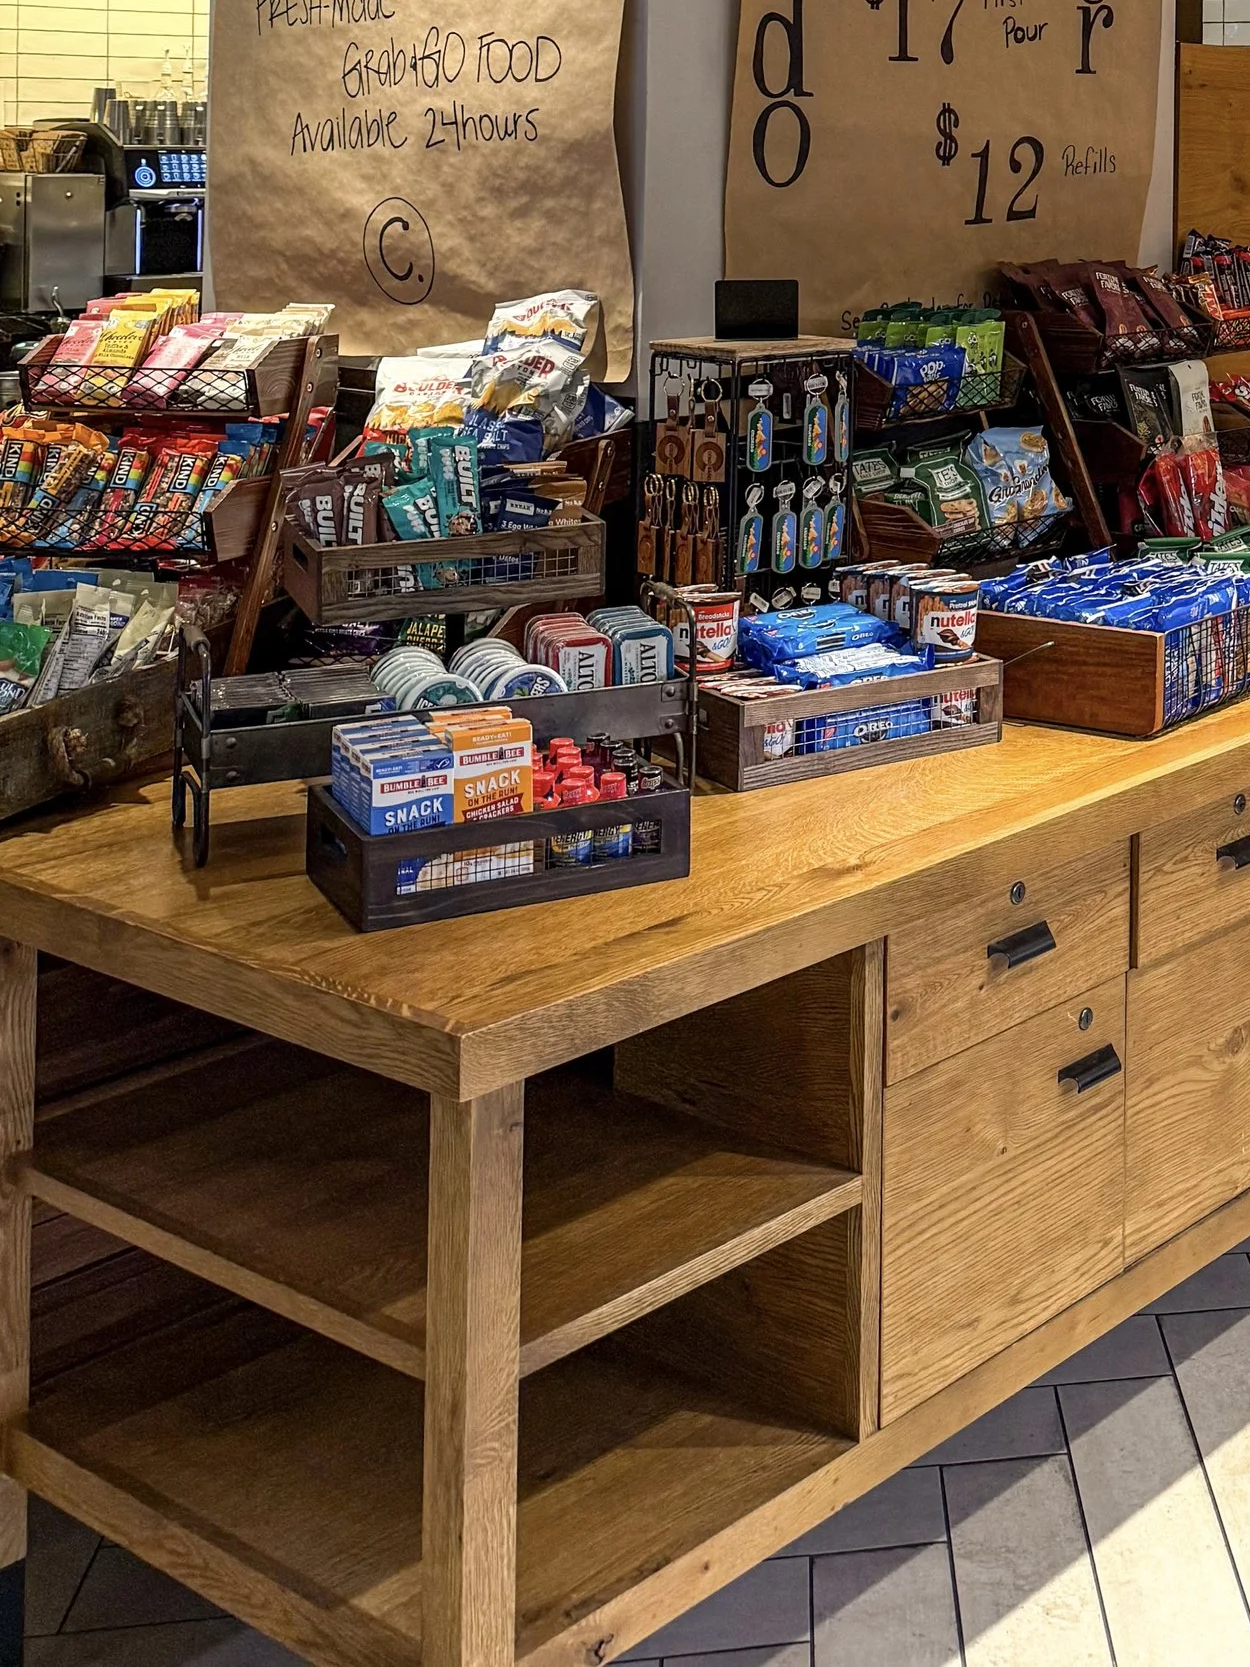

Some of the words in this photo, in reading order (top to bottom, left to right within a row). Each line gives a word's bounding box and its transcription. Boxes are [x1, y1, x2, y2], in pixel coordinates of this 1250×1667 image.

[1002, 16, 1049, 49] Pour
[476, 31, 562, 84] FOOD
[291, 107, 408, 157] Available
[935, 102, 1046, 225] $12
[1060, 143, 1117, 177] Refills
[4, 443, 22, 478] KIND
[114, 452, 134, 484] KIND
[173, 456, 197, 489] KIND
[206, 456, 229, 486] KIND
[454, 445, 478, 508] BUILT
[315, 495, 337, 547] BUIL
[853, 721, 893, 738] OREO
[462, 752, 498, 765] BUMBLE
[505, 748, 522, 758] BEE
[383, 780, 420, 793] BUMBLE
[428, 775, 446, 786] BEE
[464, 769, 521, 798] SNACK
[468, 798, 479, 807] ON
[481, 794, 498, 804] THE
[499, 787, 518, 798] RUN!
[385, 797, 443, 826] SNACK
[402, 821, 417, 832] THE
[420, 814, 440, 829] RUN!
[466, 804, 496, 818] CHICKEN
[497, 797, 519, 810] SALAD
